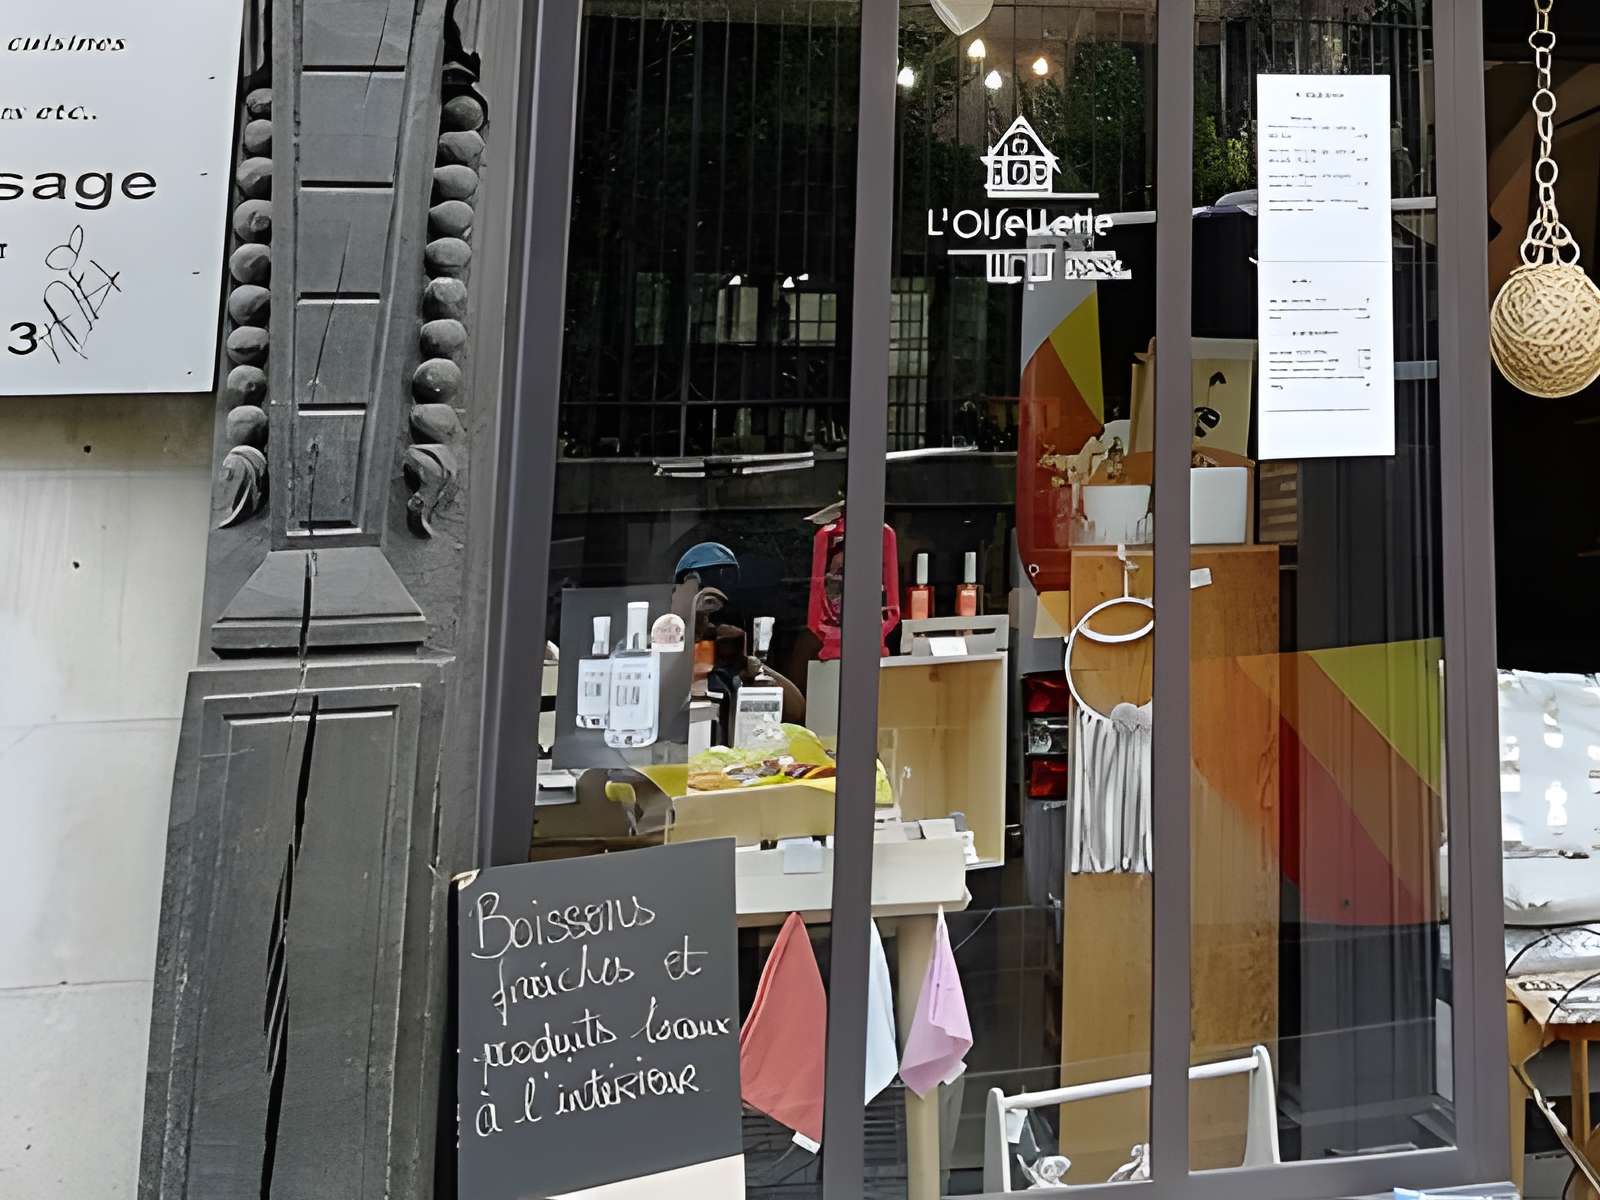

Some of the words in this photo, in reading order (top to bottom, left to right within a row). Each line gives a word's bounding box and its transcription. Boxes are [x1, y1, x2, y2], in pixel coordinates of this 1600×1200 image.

[7, 321, 38, 356] 3
[471, 891, 656, 959] Boissons
[663, 934, 709, 981] et
[473, 1008, 618, 1086] produits
